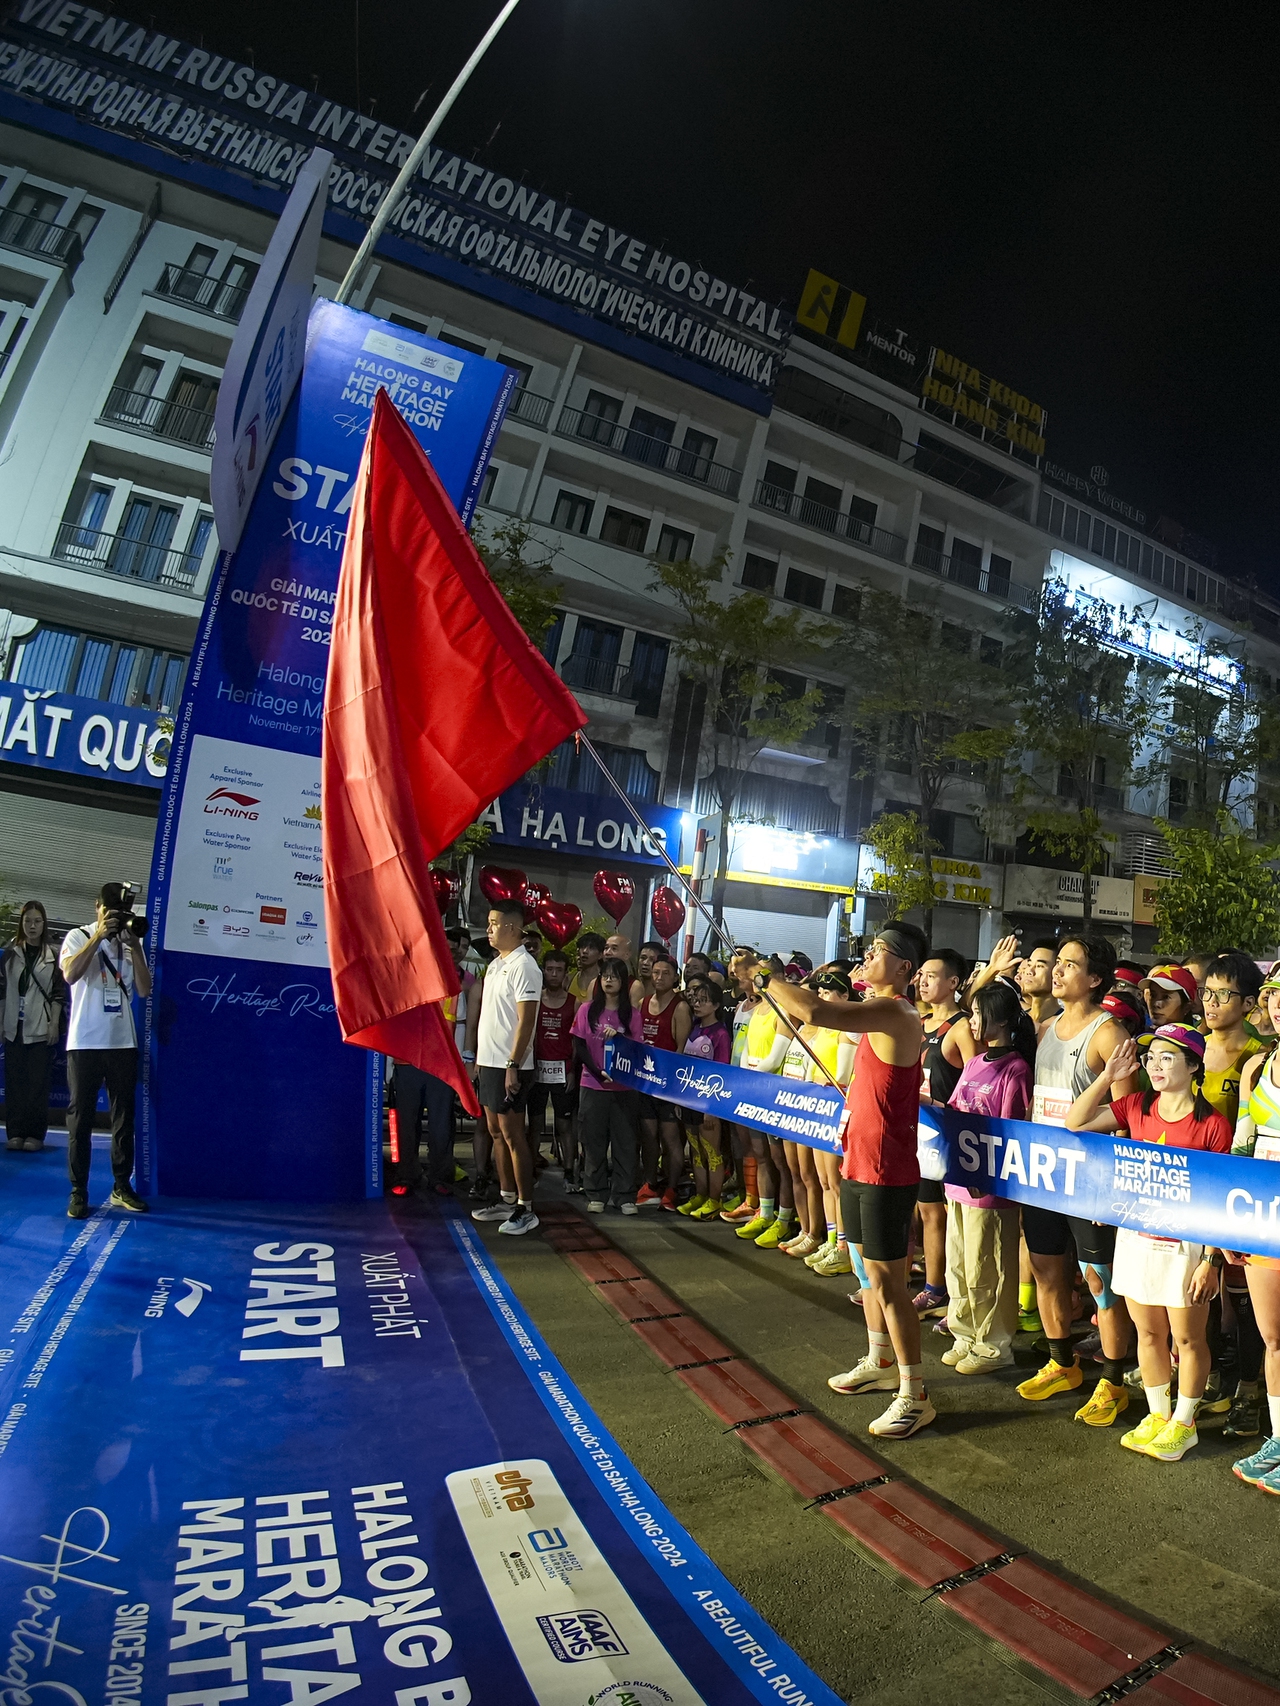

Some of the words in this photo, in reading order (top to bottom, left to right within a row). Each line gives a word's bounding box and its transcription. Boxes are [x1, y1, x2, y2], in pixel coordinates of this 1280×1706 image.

[0, 42, 181, 136] ЕЖДУНАРОДНАЯ
[690, 322, 774, 387] КЛИНИКА
[308, 101, 573, 241] INTERNATIONAL
[579, 218, 647, 273] EYE
[645, 253, 784, 341] HOSPITAL
[866, 331, 916, 366] MENTOR
[354, 357, 420, 388] HALONG
[421, 380, 454, 400] BAY
[934, 348, 981, 391] NHA
[988, 377, 1043, 425] KHOA
[346, 371, 448, 418] HERITAGE
[922, 375, 999, 431] HOÀNG
[472, 460, 483, 486] HALONG
[479, 449, 487, 463] BAY
[484, 420, 498, 450] HERITAGE
[493, 388, 509, 422] MARATHON
[506, 374, 514, 389] 2024
[1044, 460, 1096, 496] HAPPY
[1097, 488, 1147, 525] WORLD
[282, 518, 348, 552] XUẤT
[270, 577, 303, 596] GIẢI
[230, 589, 278, 612] QUỐC
[281, 600, 302, 618] TẾ
[301, 605, 316, 621] DI
[193, 641, 209, 680] BEAUTIFUL
[203, 606, 217, 640] RUNNING
[212, 576, 226, 605] COURSE
[300, 626, 332, 646] 202
[257, 660, 325, 694] Halong
[183, 702, 194, 721] 2024
[217, 681, 298, 717] Heritage
[179, 722, 190, 744] LONG
[248, 714, 303, 735] November
[172, 757, 183, 774] SẢN
[223, 765, 253, 777] Exclusive
[210, 773, 236, 786] Apparel
[235, 777, 264, 789] Sponsor
[165, 794, 177, 818] QUỐC
[203, 804, 260, 821] LI-NING
[158, 819, 172, 864] MARATHON
[203, 837, 224, 848] Water
[223, 840, 251, 852] Sponsor
[205, 828, 234, 841] Exclusive
[234, 834, 251, 843] Pure
[520, 806, 568, 849] HẠ
[576, 816, 667, 857] LONG
[283, 841, 312, 853] Exclusive
[291, 850, 312, 861] Water
[157, 865, 166, 881] GIẢI
[213, 863, 234, 876] true
[617, 877, 631, 887] FM
[931, 858, 982, 879] KHOA
[154, 896, 162, 914] SITE
[188, 900, 219, 912] Salonpas
[256, 892, 283, 902] Partners
[525, 889, 541, 900] FM
[953, 882, 992, 904] KIM
[150, 914, 159, 953] HERITAGE
[186, 972, 282, 1017] Heritage
[615, 1052, 631, 1074] km
[774, 1090, 817, 1113] HALONG
[816, 1099, 839, 1118] BAY
[733, 1102, 782, 1127] HERITAGE
[780, 1112, 842, 1143] MARATHON
[957, 1129, 1087, 1196] START
[1113, 1144, 1162, 1163] HALONG
[1163, 1152, 1188, 1168] BAY
[1114, 1158, 1191, 1188] HERITAGE
[1113, 1175, 1191, 1203] MARATHON
[360, 1251, 416, 1290] XUẤT
[144, 1276, 175, 1319] LI-NING
[239, 1241, 345, 1368] START
[10, 1316, 35, 1334] SITE
[367, 1292, 429, 1340] PHÁT
[508, 1320, 534, 1348] HERITAGE
[524, 1347, 541, 1361] SITE
[31, 1340, 61, 1372] HERITAGE
[23, 1372, 44, 1389] SITE
[538, 1370, 557, 1386] GIẢI
[545, 1384, 583, 1426] MARATHON
[572, 1424, 601, 1450] QUỐC
[589, 1448, 613, 1461] TẾ
[596, 1460, 613, 1472] DI
[604, 1470, 631, 1497] SẢN
[618, 1491, 640, 1509] HẠ
[629, 1506, 664, 1537] LONG
[557, 1552, 573, 1572] WORLD
[565, 1551, 583, 1572] ABBOTT
[651, 1536, 688, 1568] 2024
[350, 1481, 453, 1669] HALONG
[538, 1556, 557, 1580] MAJORS
[548, 1553, 572, 1587] MARATHON
[248, 1490, 362, 1706] HERITA
[692, 1588, 714, 1606] A
[113, 1603, 149, 1665] SINCE
[538, 1617, 556, 1641] CERTIFIED
[550, 1639, 567, 1660] COURSE
[555, 1617, 593, 1656] AIMS
[577, 1613, 620, 1653] IAAF
[702, 1601, 776, 1678] BEAUTIFUL
[595, 1680, 631, 1700] WORLD
[633, 1680, 674, 1704] RUNNING
